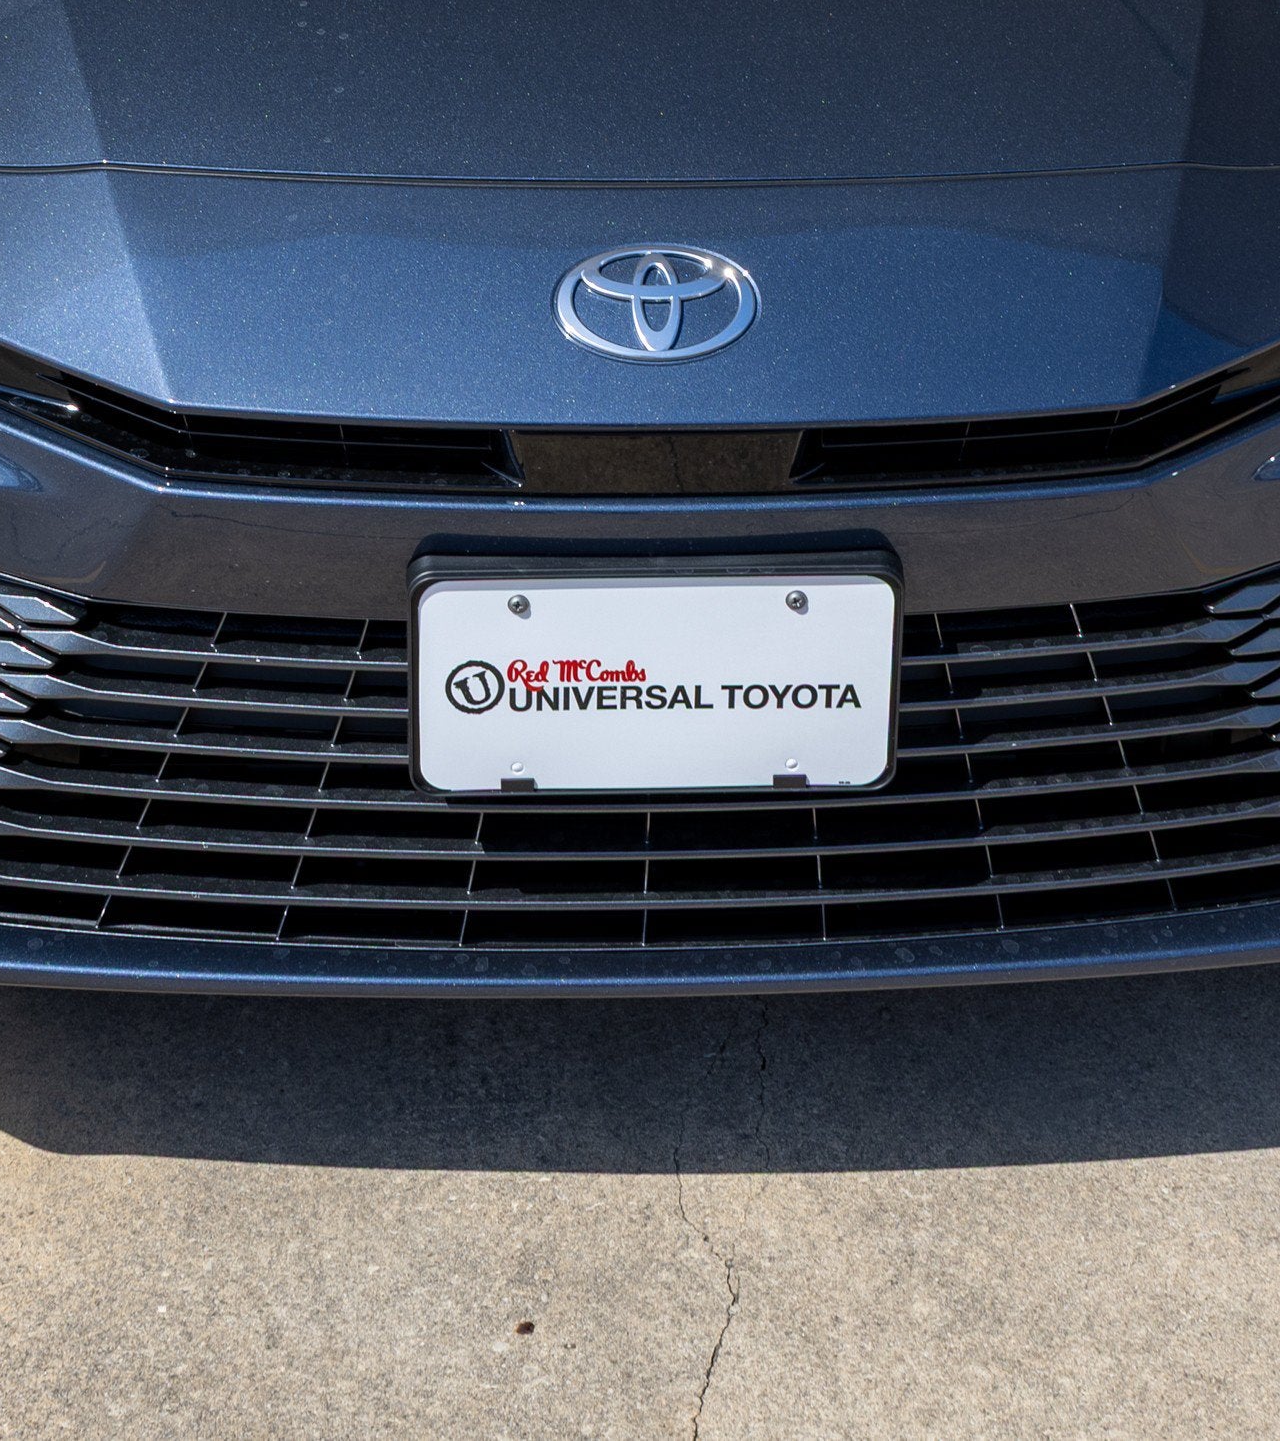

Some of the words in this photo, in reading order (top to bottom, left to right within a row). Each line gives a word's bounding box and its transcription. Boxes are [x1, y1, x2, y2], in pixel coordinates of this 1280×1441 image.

[507, 659, 549, 692] Red
[552, 659, 646, 682] McCombs
[509, 684, 714, 712] UNIVERSAL
[721, 684, 862, 709] TOYOTA
